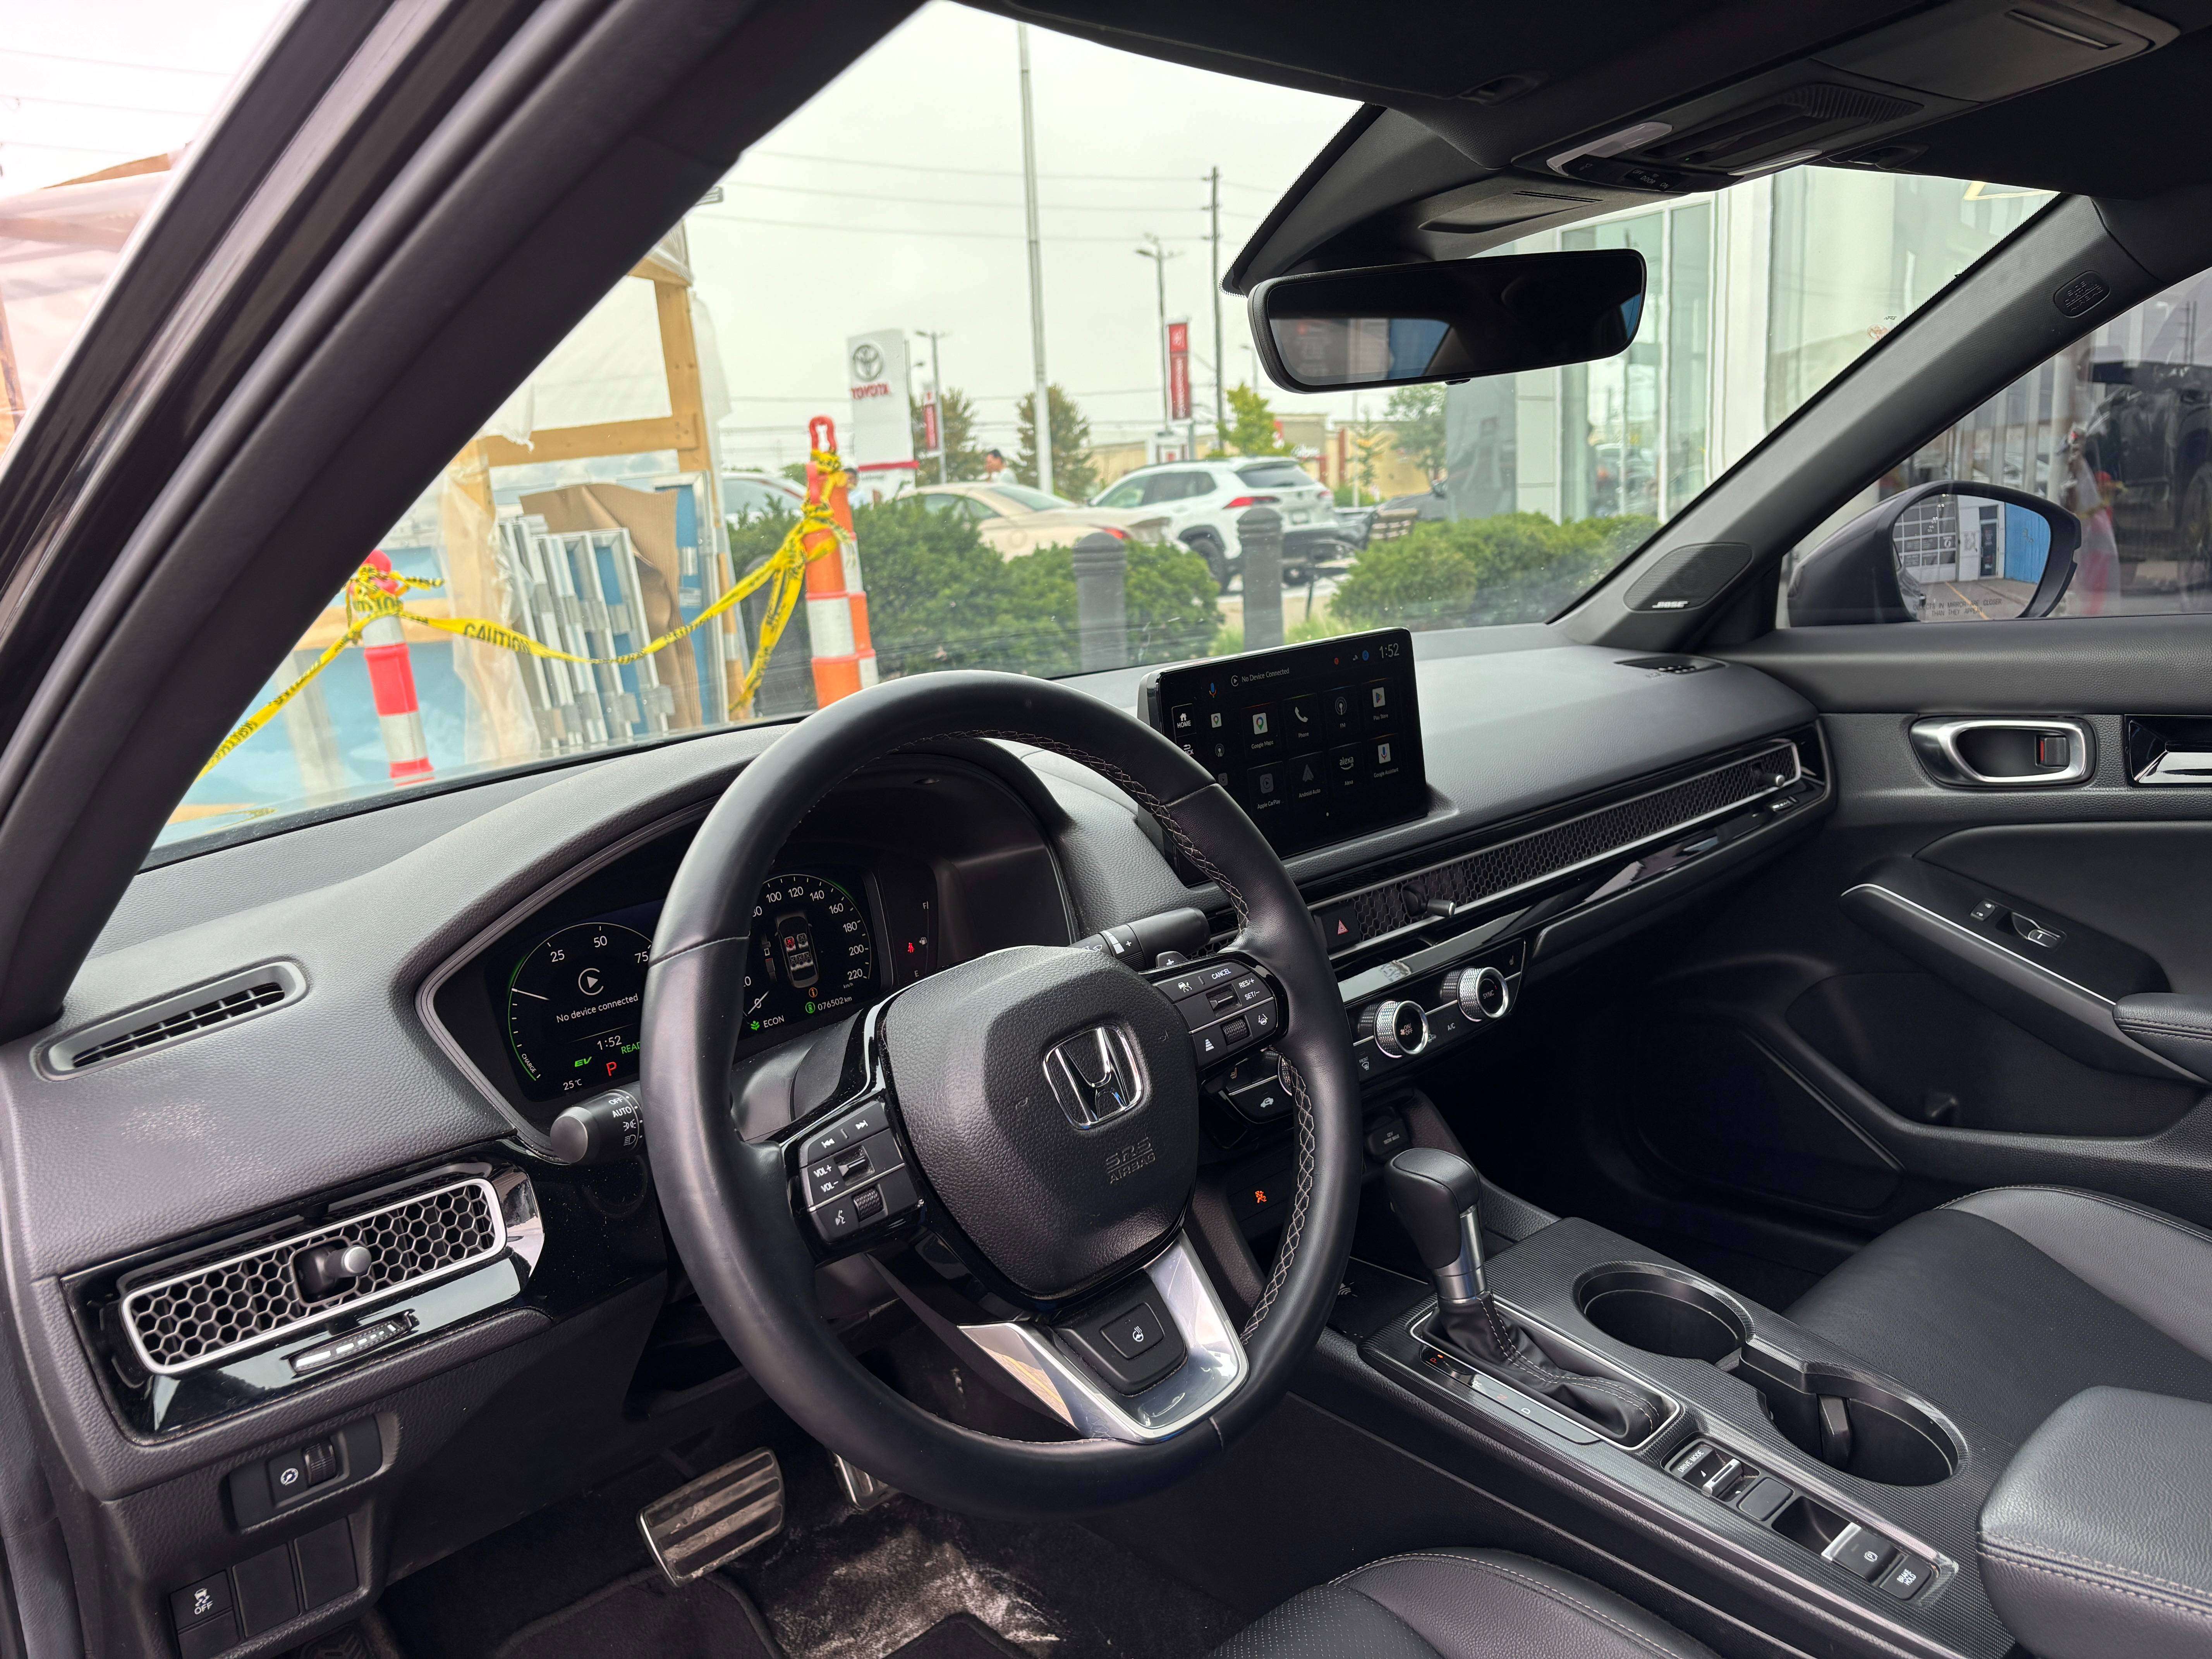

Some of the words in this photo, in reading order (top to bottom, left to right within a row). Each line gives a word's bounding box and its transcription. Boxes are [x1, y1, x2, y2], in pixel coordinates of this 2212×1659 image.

[1640, 175, 1656, 184] DOOR
[851, 383, 889, 399] TOYOTA
[1379, 643, 1400, 658] 1:52
[1241, 673, 1249, 682] No
[1250, 672, 1265, 682] Device
[1266, 667, 1290, 678] Connected
[1177, 720, 1192, 728] HOME
[1340, 756, 1354, 766] alexa
[1257, 801, 1267, 810] Apple
[766, 891, 782, 903] 100
[788, 886, 804, 898] 120
[810, 890, 825, 902] 140
[829, 903, 843, 914] 160
[843, 921, 857, 933] 180
[594, 935, 608, 948] 50
[550, 949, 565, 962] 25
[848, 944, 864, 956] 200
[634, 951, 649, 963] 75
[847, 968, 863, 981] 220
[1211, 968, 1231, 980] CANCEL
[1482, 989, 1494, 999] SYNC
[556, 1013, 569, 1023] No
[570, 1006, 597, 1019] device
[598, 993, 639, 1012] connected
[817, 997, 844, 1011] 076502
[763, 1015, 785, 1028] ECON
[1447, 1022, 1456, 1031] A/C
[597, 1035, 622, 1050] 1:52
[621, 1041, 640, 1054] READ
[521, 1053, 537, 1073] CHARGE
[574, 1056, 592, 1067] EV
[606, 1061, 617, 1076] P
[612, 1106, 632, 1118] AUTO
[1106, 1136, 1152, 1166] SRS
[1109, 1152, 1156, 1185] AIRBAG
[1677, 1460, 1693, 1472] DRIVE
[1689, 1449, 1704, 1462] MODE
[1896, 1568, 1911, 1583] BRAKE
[1903, 1573, 1917, 1586] HOLD
[194, 1601, 214, 1615] OFF
